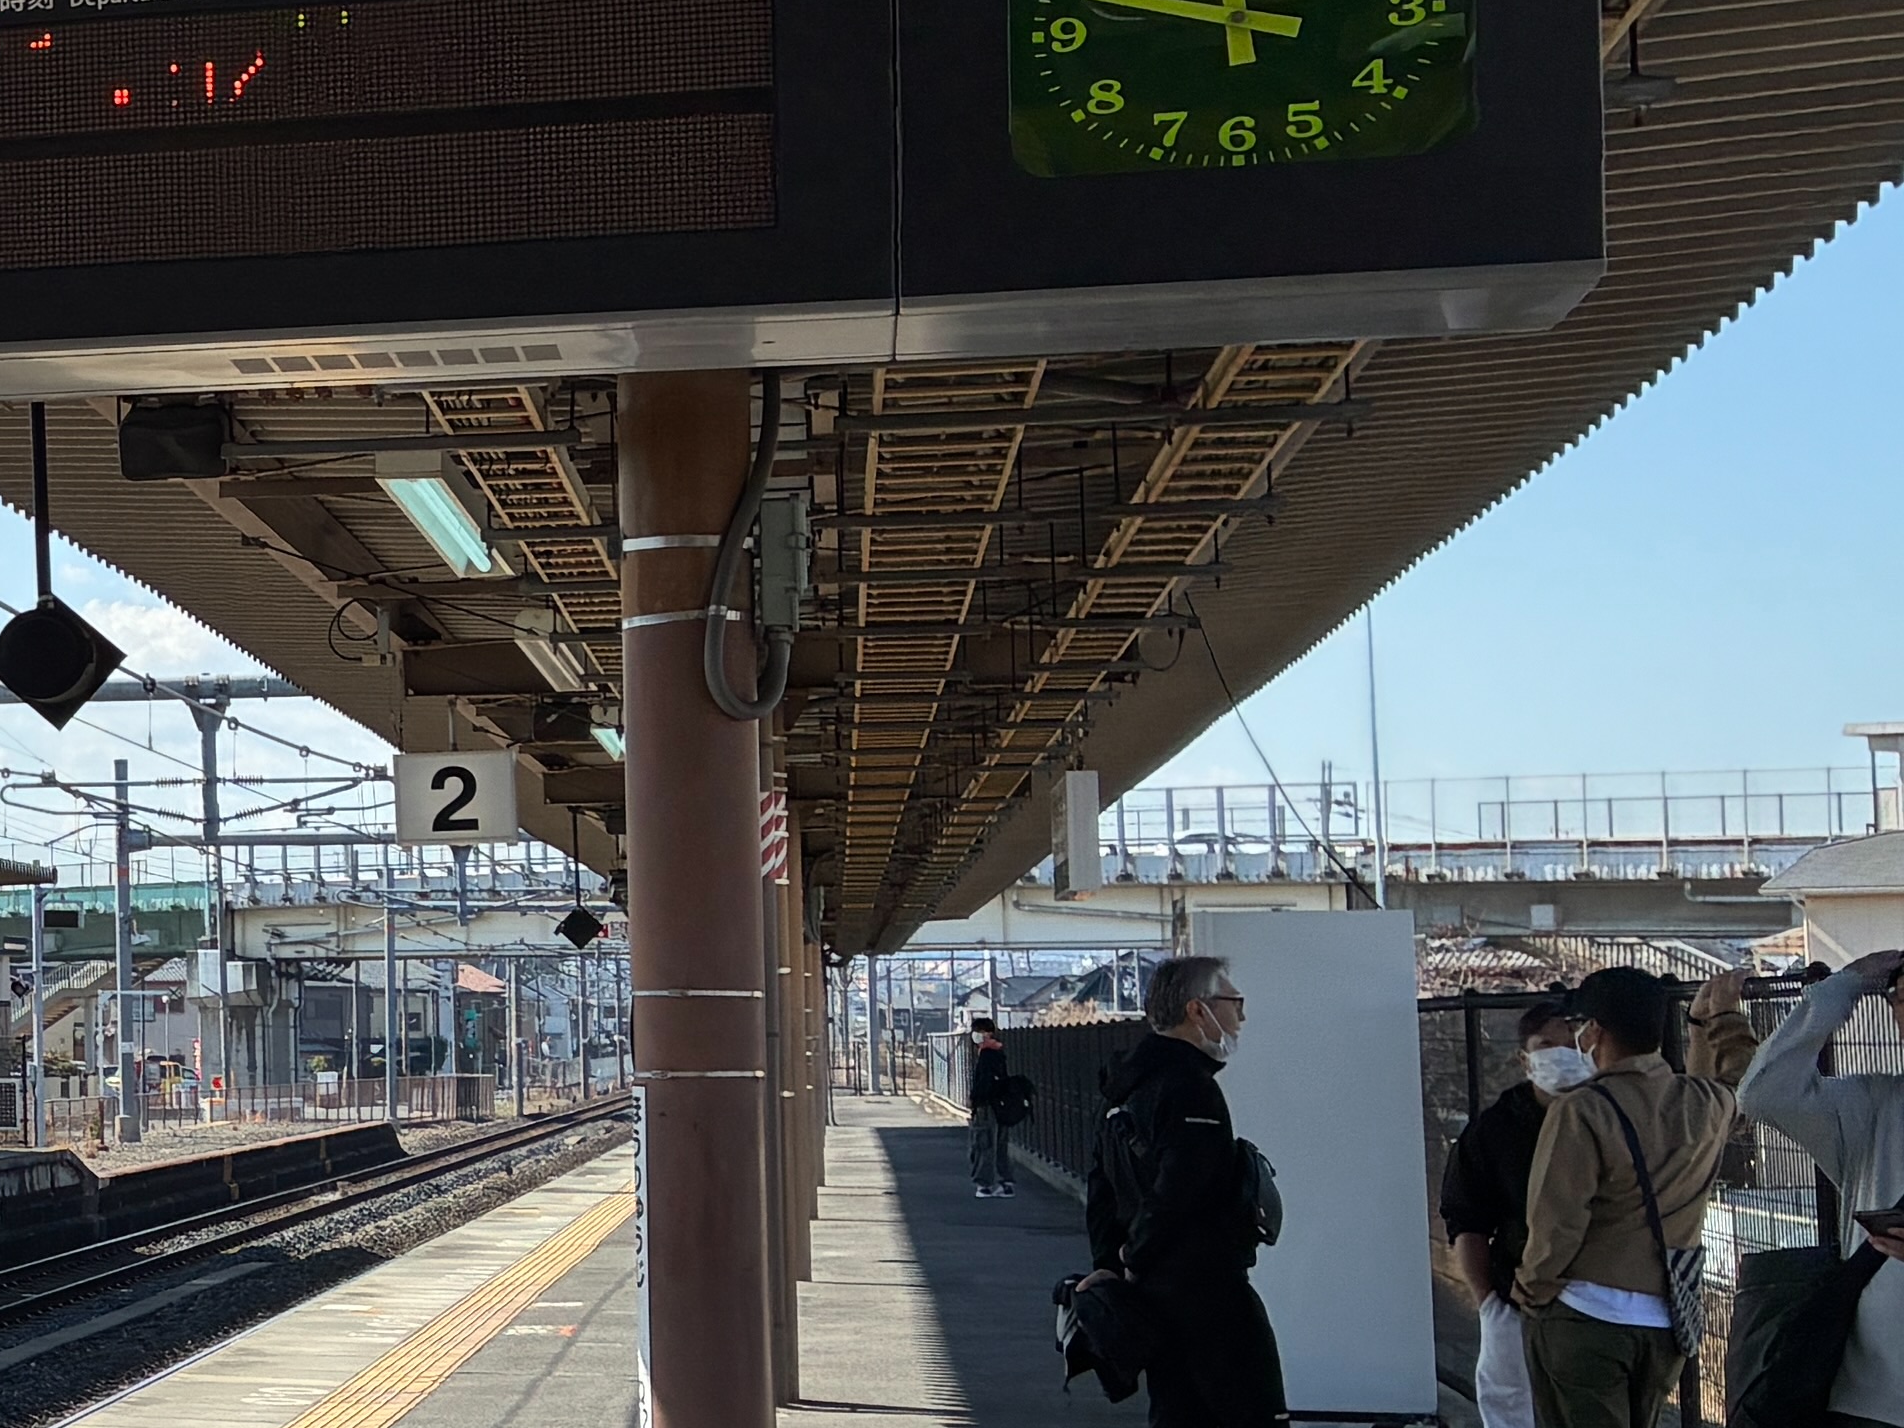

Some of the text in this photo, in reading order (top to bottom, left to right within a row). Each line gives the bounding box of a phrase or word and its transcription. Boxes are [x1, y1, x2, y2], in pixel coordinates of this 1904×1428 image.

[1050, 18, 1087, 53] 9
[1352, 59, 1394, 94] 4
[1087, 80, 1125, 115] 8
[1153, 111, 1188, 147] 7
[1217, 116, 1256, 152] 6
[1285, 101, 1323, 138] 5
[431, 766, 479, 832] 2
